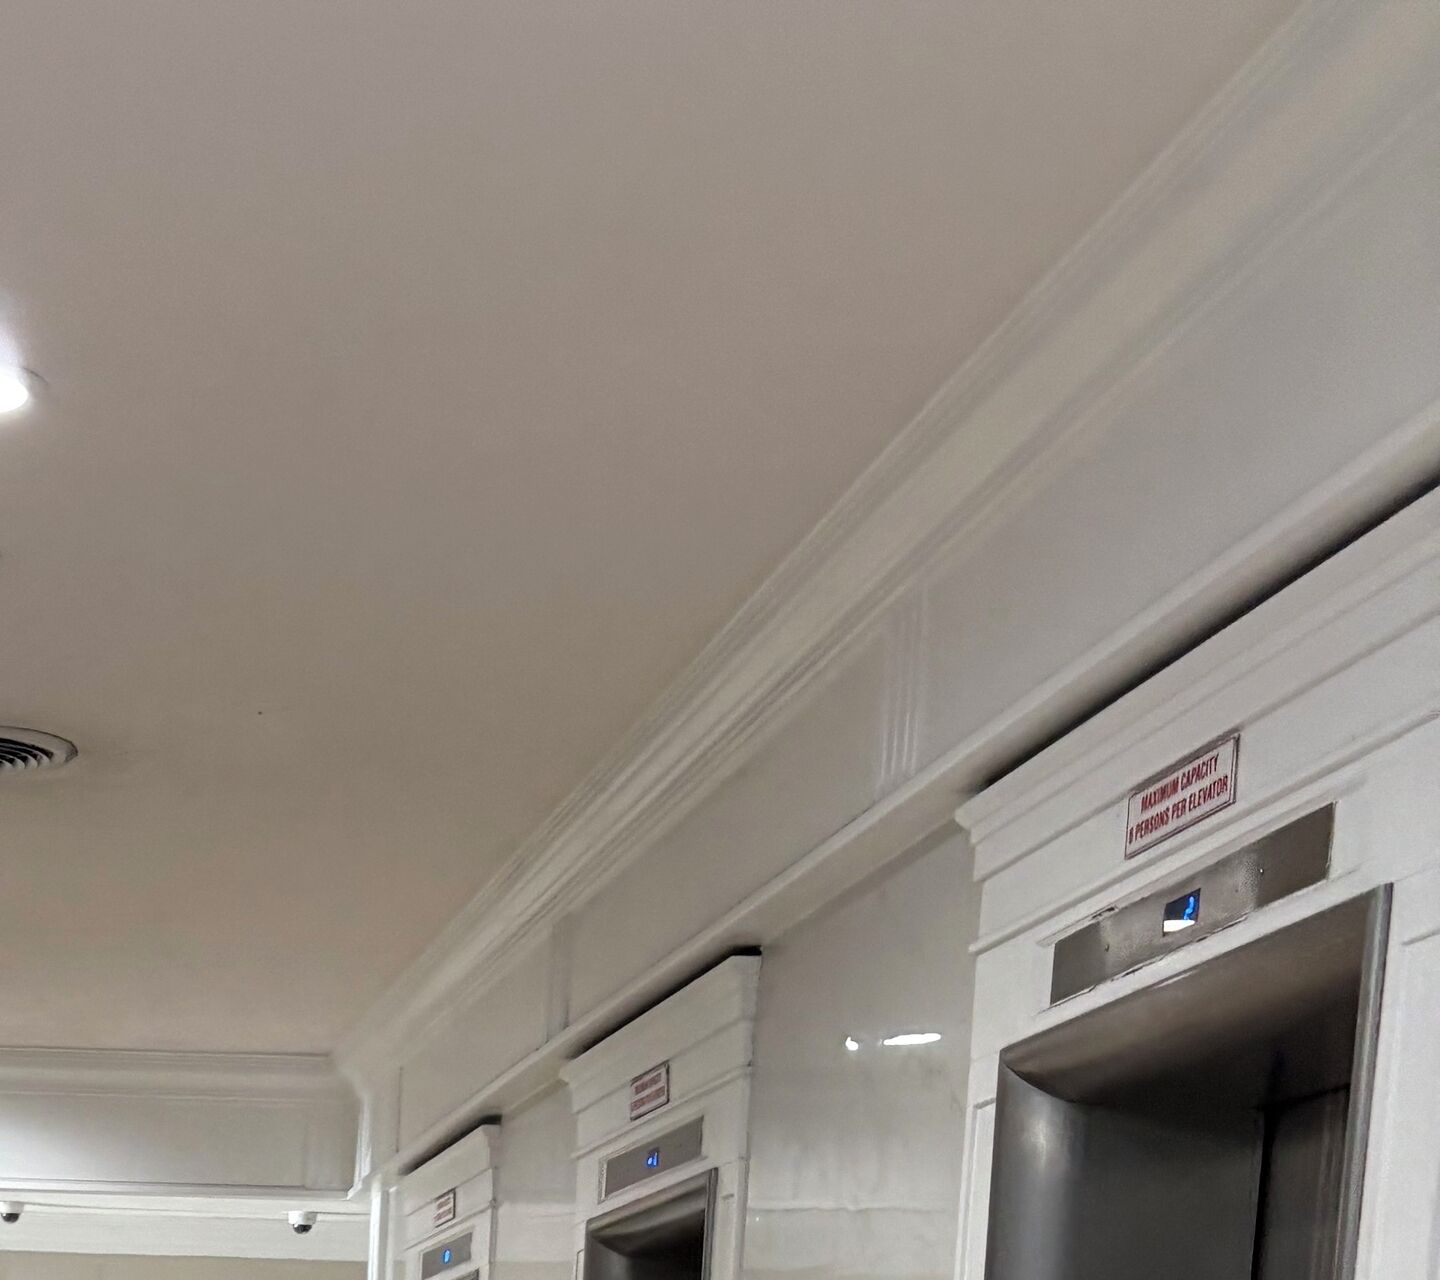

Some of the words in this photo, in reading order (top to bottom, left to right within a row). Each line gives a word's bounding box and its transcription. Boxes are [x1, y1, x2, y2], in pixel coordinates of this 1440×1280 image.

[1135, 807, 1170, 842] PERSONS
[1171, 798, 1187, 822] PER
[1188, 775, 1228, 812] ELEVATOR
[1141, 777, 1179, 814] MAXIMUM
[1181, 752, 1219, 791] CAPACITY
